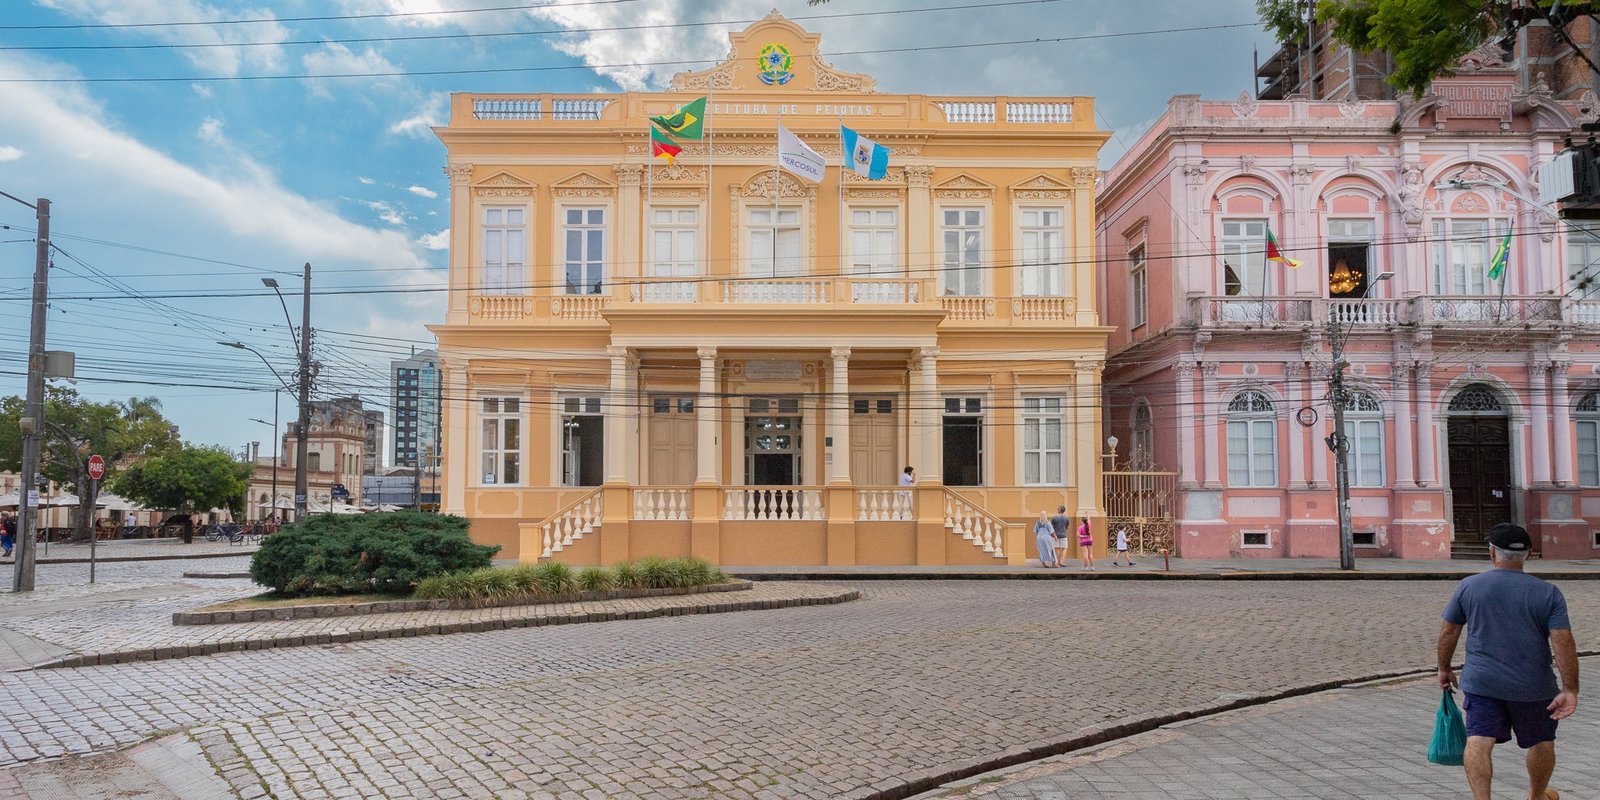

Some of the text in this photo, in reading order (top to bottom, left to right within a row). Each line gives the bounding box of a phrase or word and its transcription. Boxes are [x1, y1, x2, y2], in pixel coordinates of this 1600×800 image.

[781, 104, 798, 115] DE
[816, 104, 873, 115] PELOTAS
[782, 155, 818, 175] MERCOSUL
[90, 462, 103, 472] PARE
